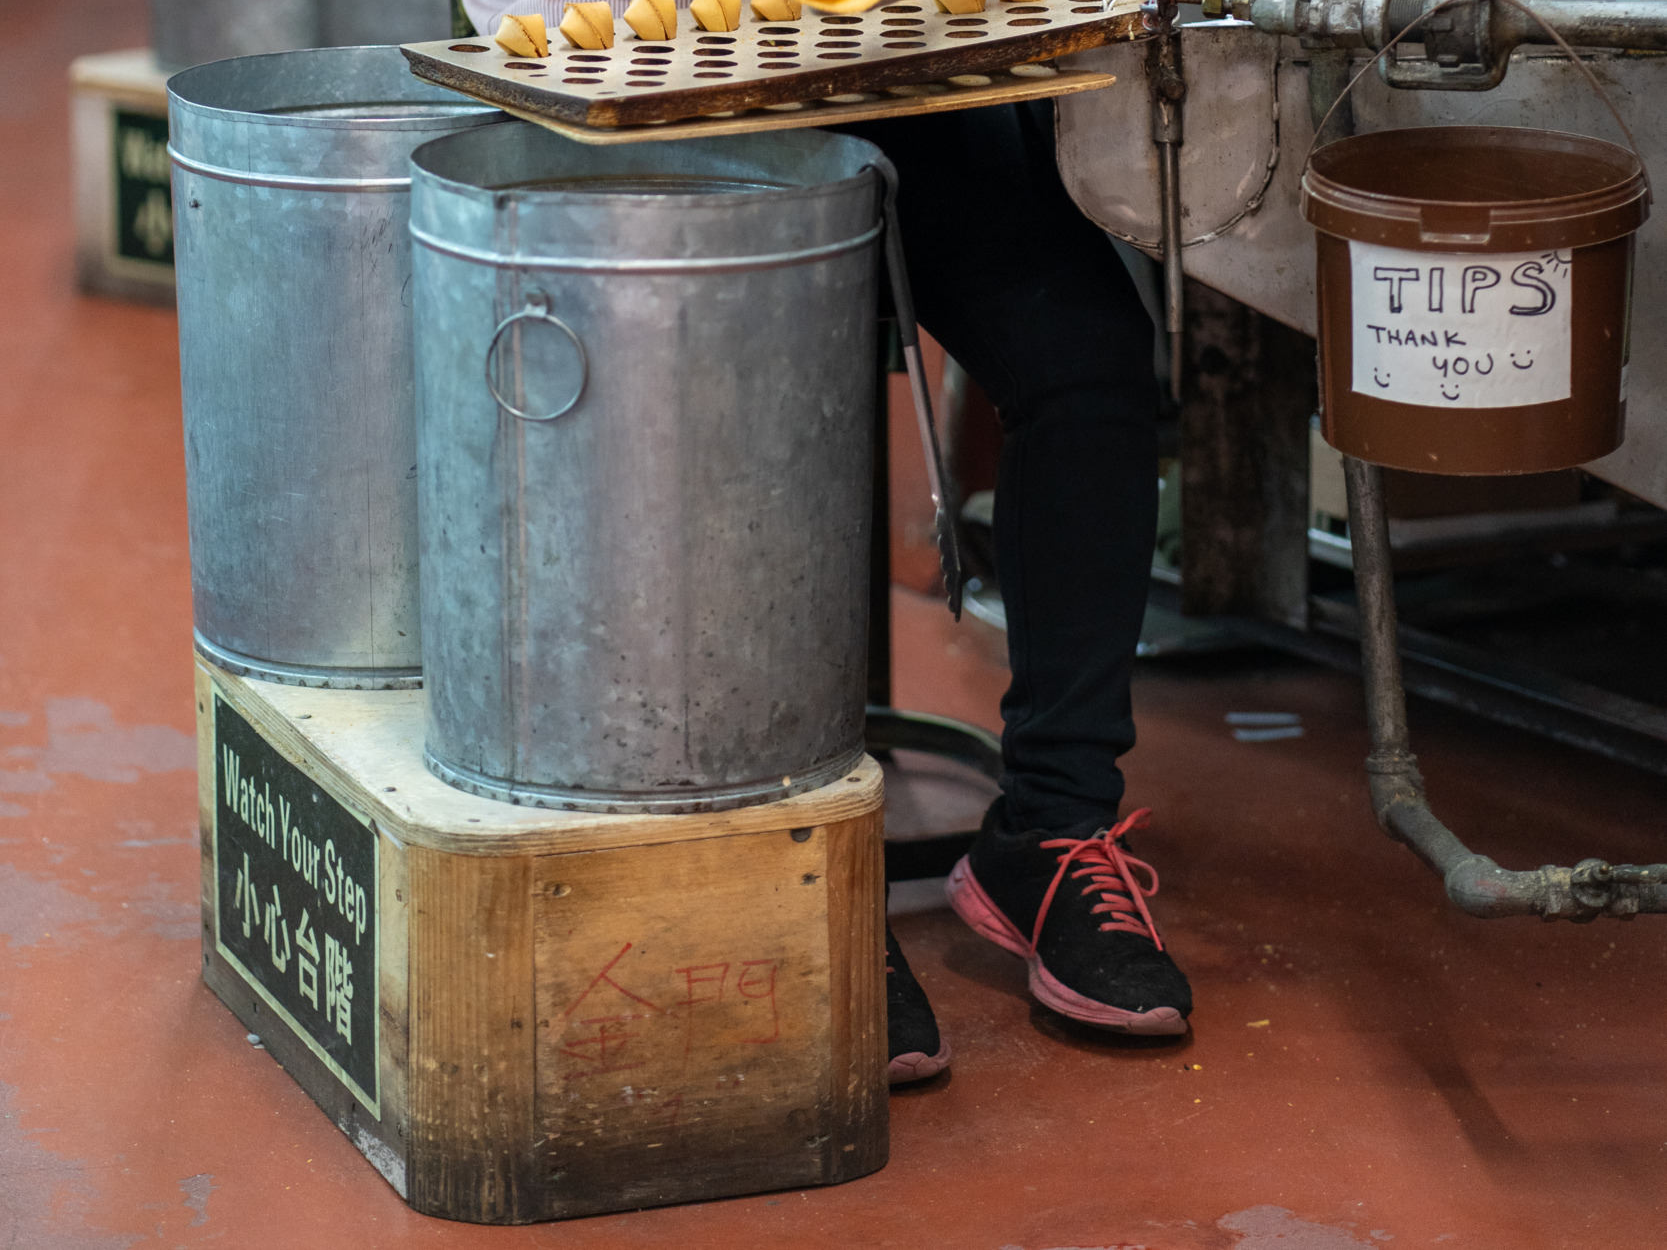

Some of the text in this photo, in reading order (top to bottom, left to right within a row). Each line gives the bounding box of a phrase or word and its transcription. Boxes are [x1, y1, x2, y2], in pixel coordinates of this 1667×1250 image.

[1374, 261, 1556, 316] TIPS
[1366, 324, 1467, 348] THANK
[1432, 353, 1494, 378] YOU
[223, 743, 367, 946] Watch Your Step
[234, 852, 354, 1046] 小心台階
